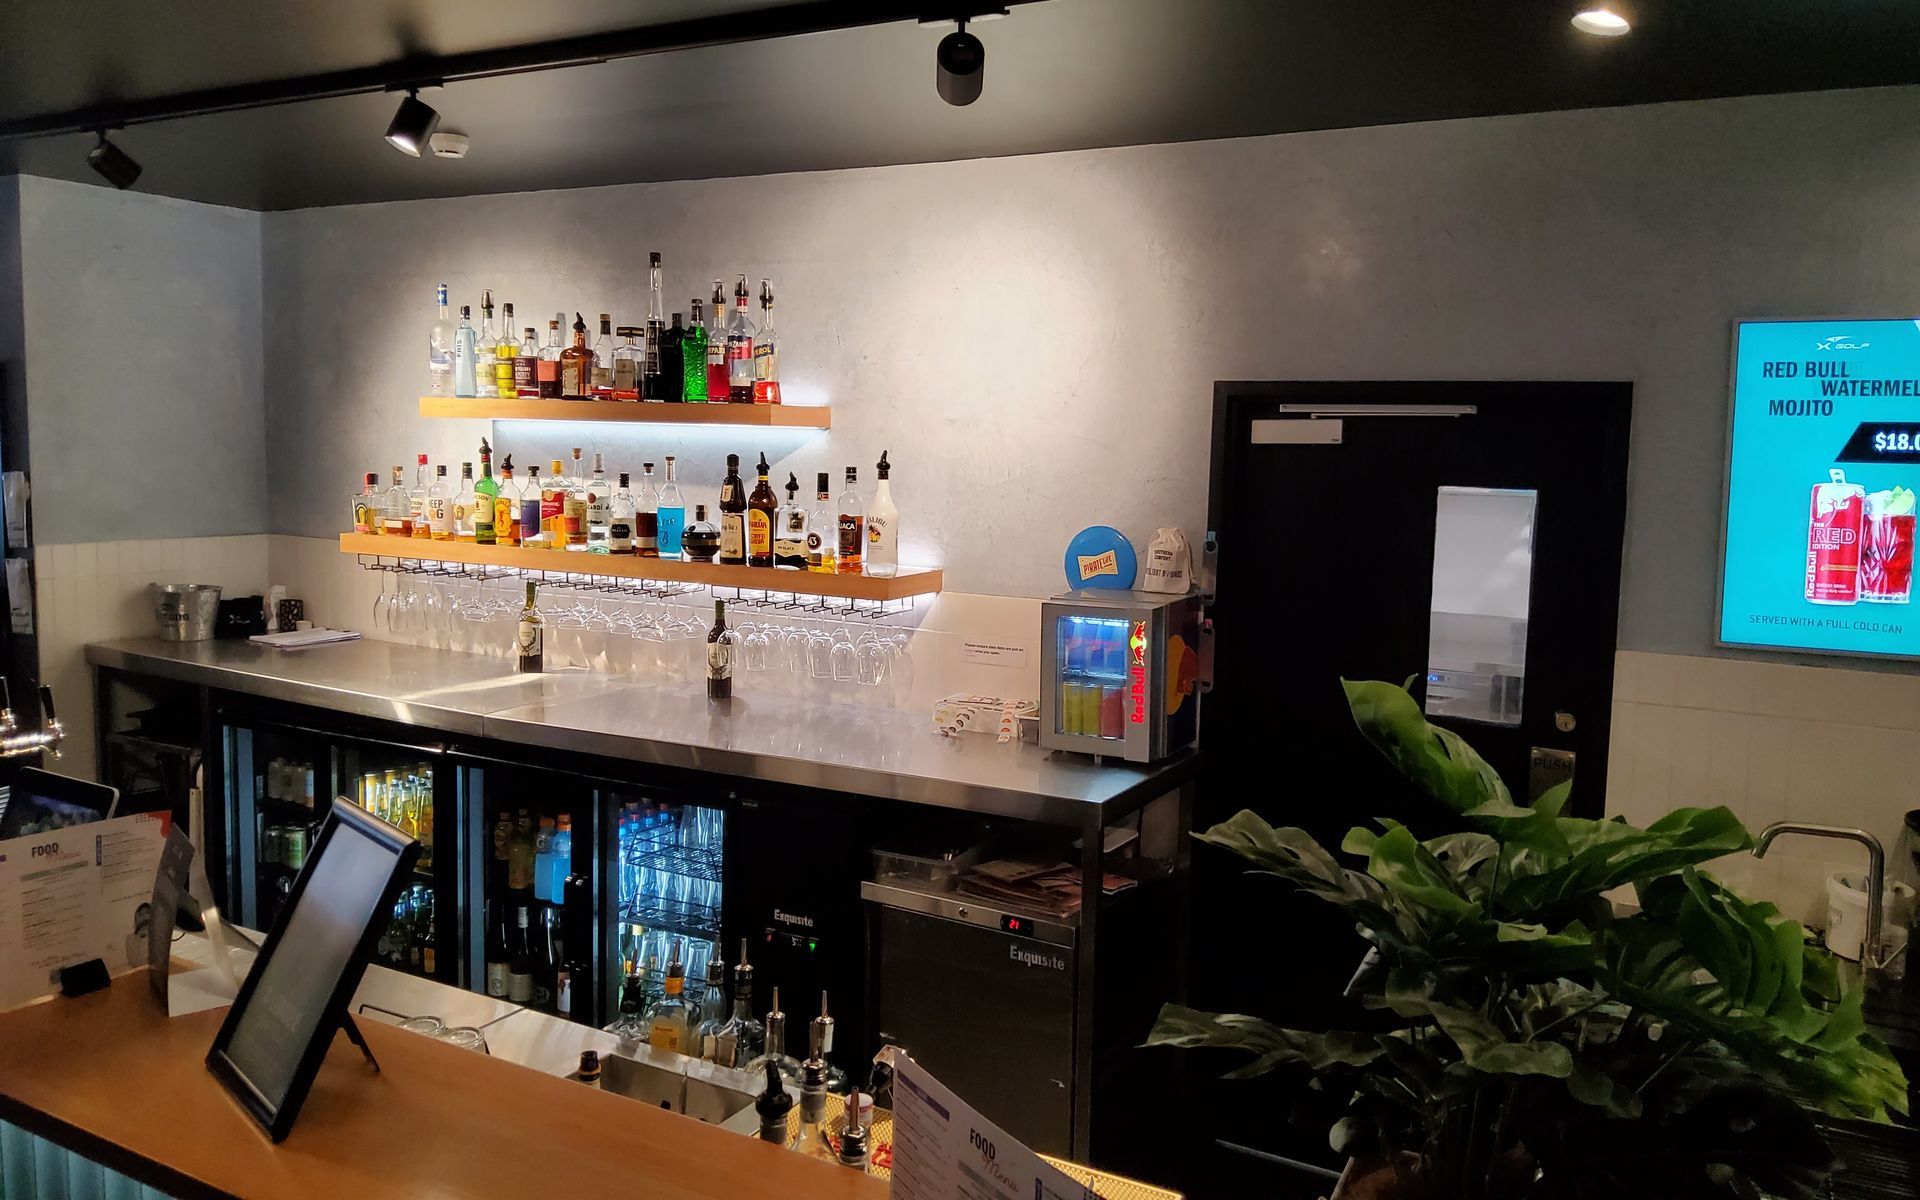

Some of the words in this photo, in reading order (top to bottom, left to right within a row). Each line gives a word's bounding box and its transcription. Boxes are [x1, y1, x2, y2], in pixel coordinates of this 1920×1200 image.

[1835, 342, 1871, 350] GOLF
[1763, 361, 1798, 378] RED
[1805, 361, 1850, 378] BULL
[1821, 379, 1920, 397] WATERMEL
[1768, 399, 1834, 417] MOJITO
[1812, 527, 1857, 545] RED
[1749, 614, 1788, 625] SERVED
[1790, 617, 1814, 627] WITH
[1816, 618, 1823, 628] A
[1826, 619, 1850, 630] FULL
[1853, 621, 1880, 632] COLD
[1882, 623, 1903, 634] CAN
[1534, 757, 1572, 773] PUSH
[31, 842, 60, 858] FOOD
[774, 908, 814, 927] Exquisite
[1009, 944, 1065, 970] Exquisite
[969, 1127, 996, 1161] FOOD
